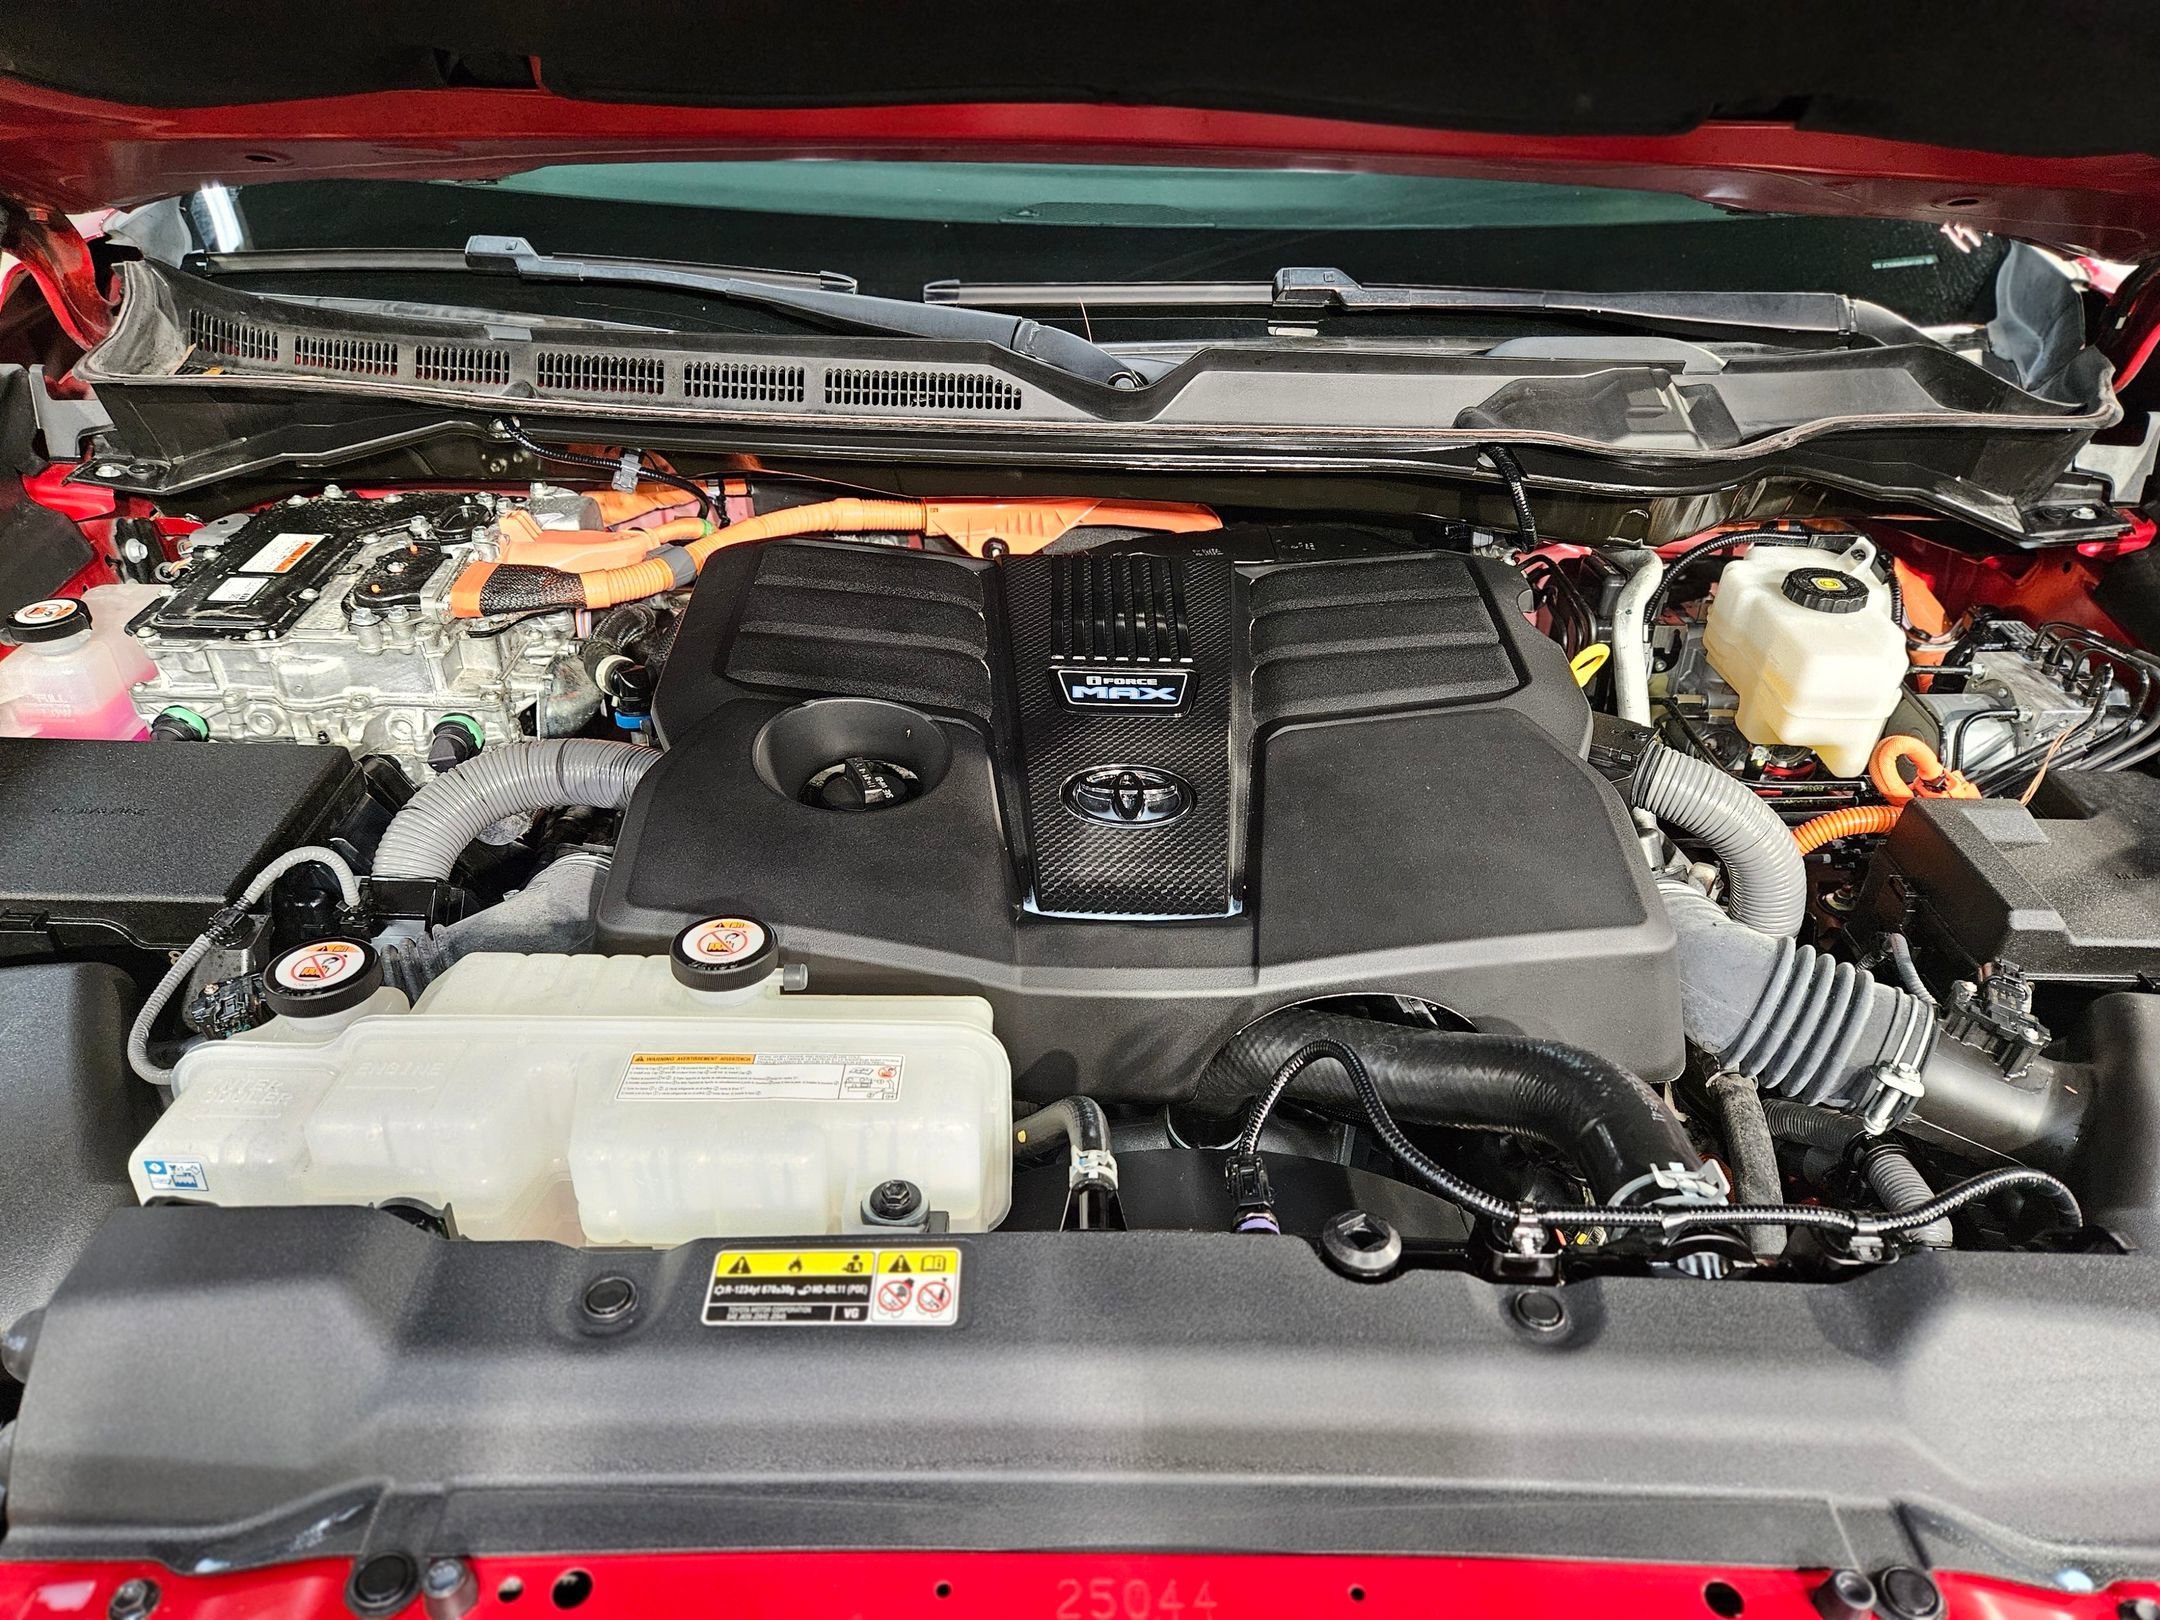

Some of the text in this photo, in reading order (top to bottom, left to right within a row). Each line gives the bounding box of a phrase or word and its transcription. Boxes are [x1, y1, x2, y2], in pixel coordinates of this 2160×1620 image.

[1071, 685, 1177, 700] MAX
[843, 1308, 860, 1319] VG
[1055, 1577, 1219, 1620] 25044
